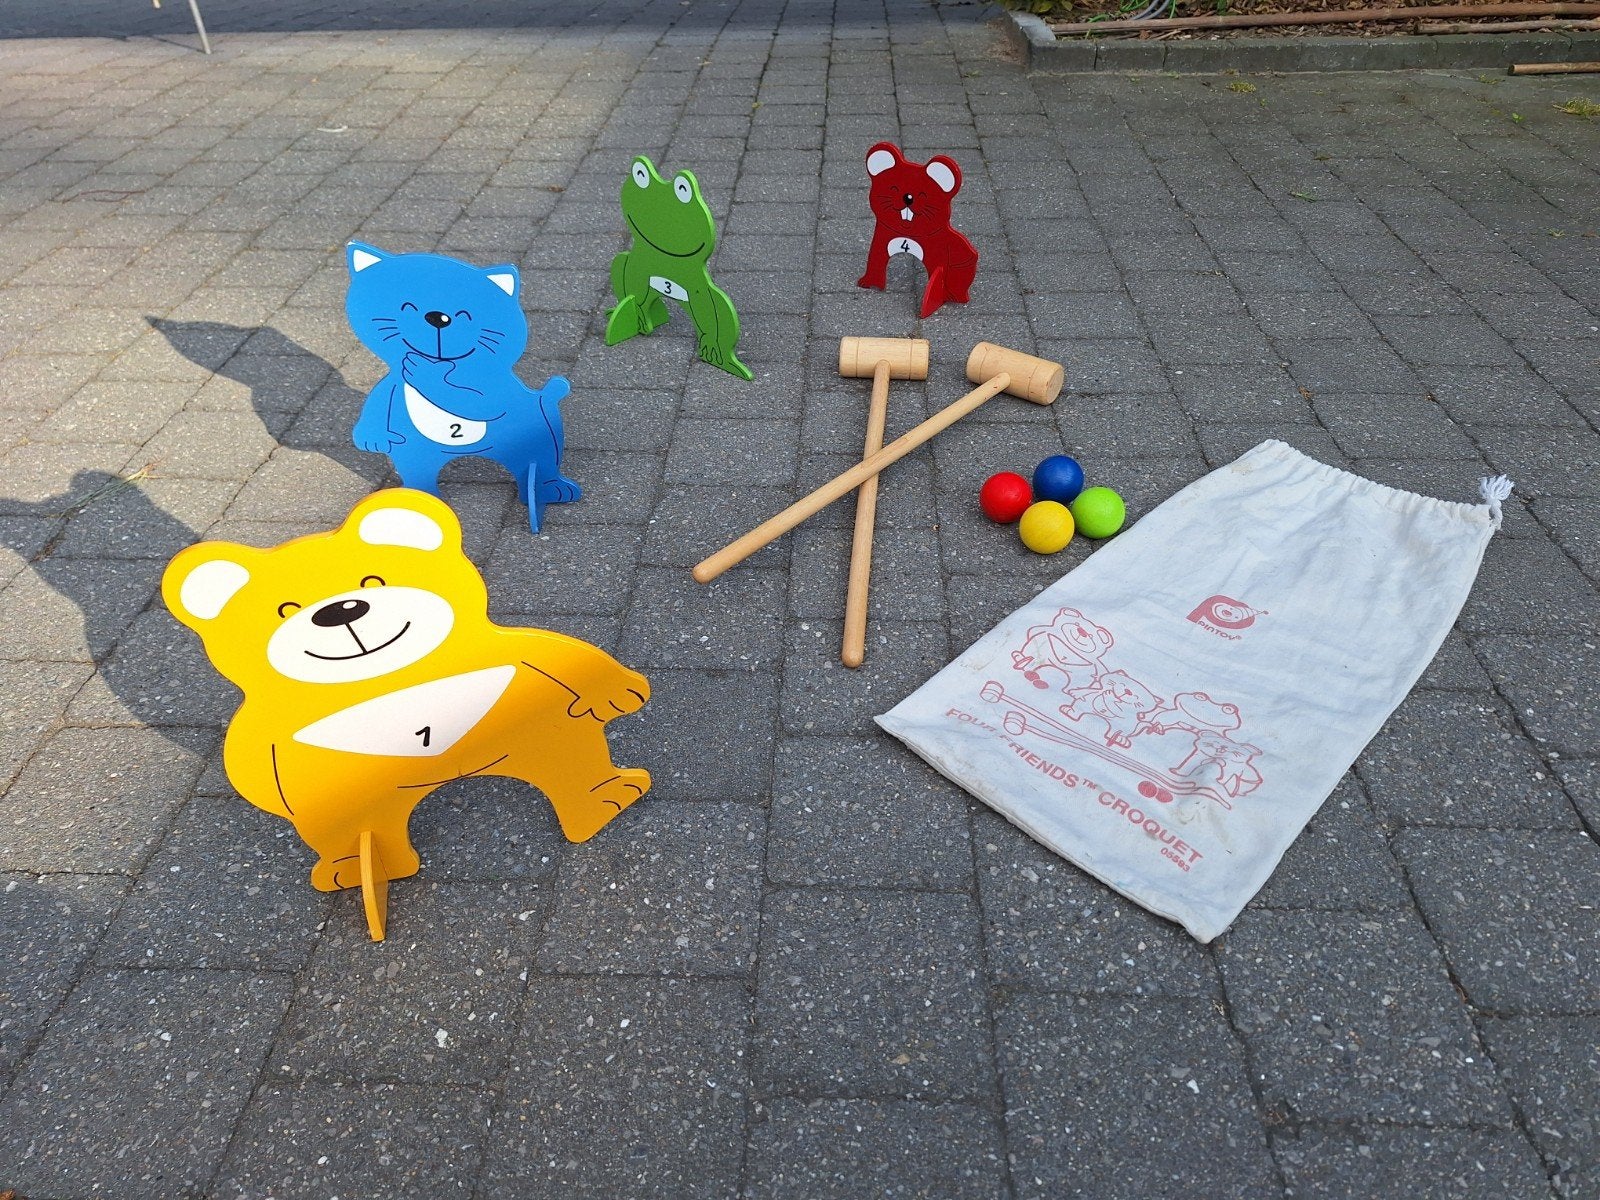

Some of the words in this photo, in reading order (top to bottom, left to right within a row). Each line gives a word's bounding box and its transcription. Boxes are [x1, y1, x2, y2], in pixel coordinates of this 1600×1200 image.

[900, 239, 910, 252] 4
[664, 281, 672, 294] 3
[450, 423, 464, 438] 2
[415, 726, 431, 747] 1
[945, 708, 996, 732] FOUR
[1098, 791, 1204, 863] CROQUET
